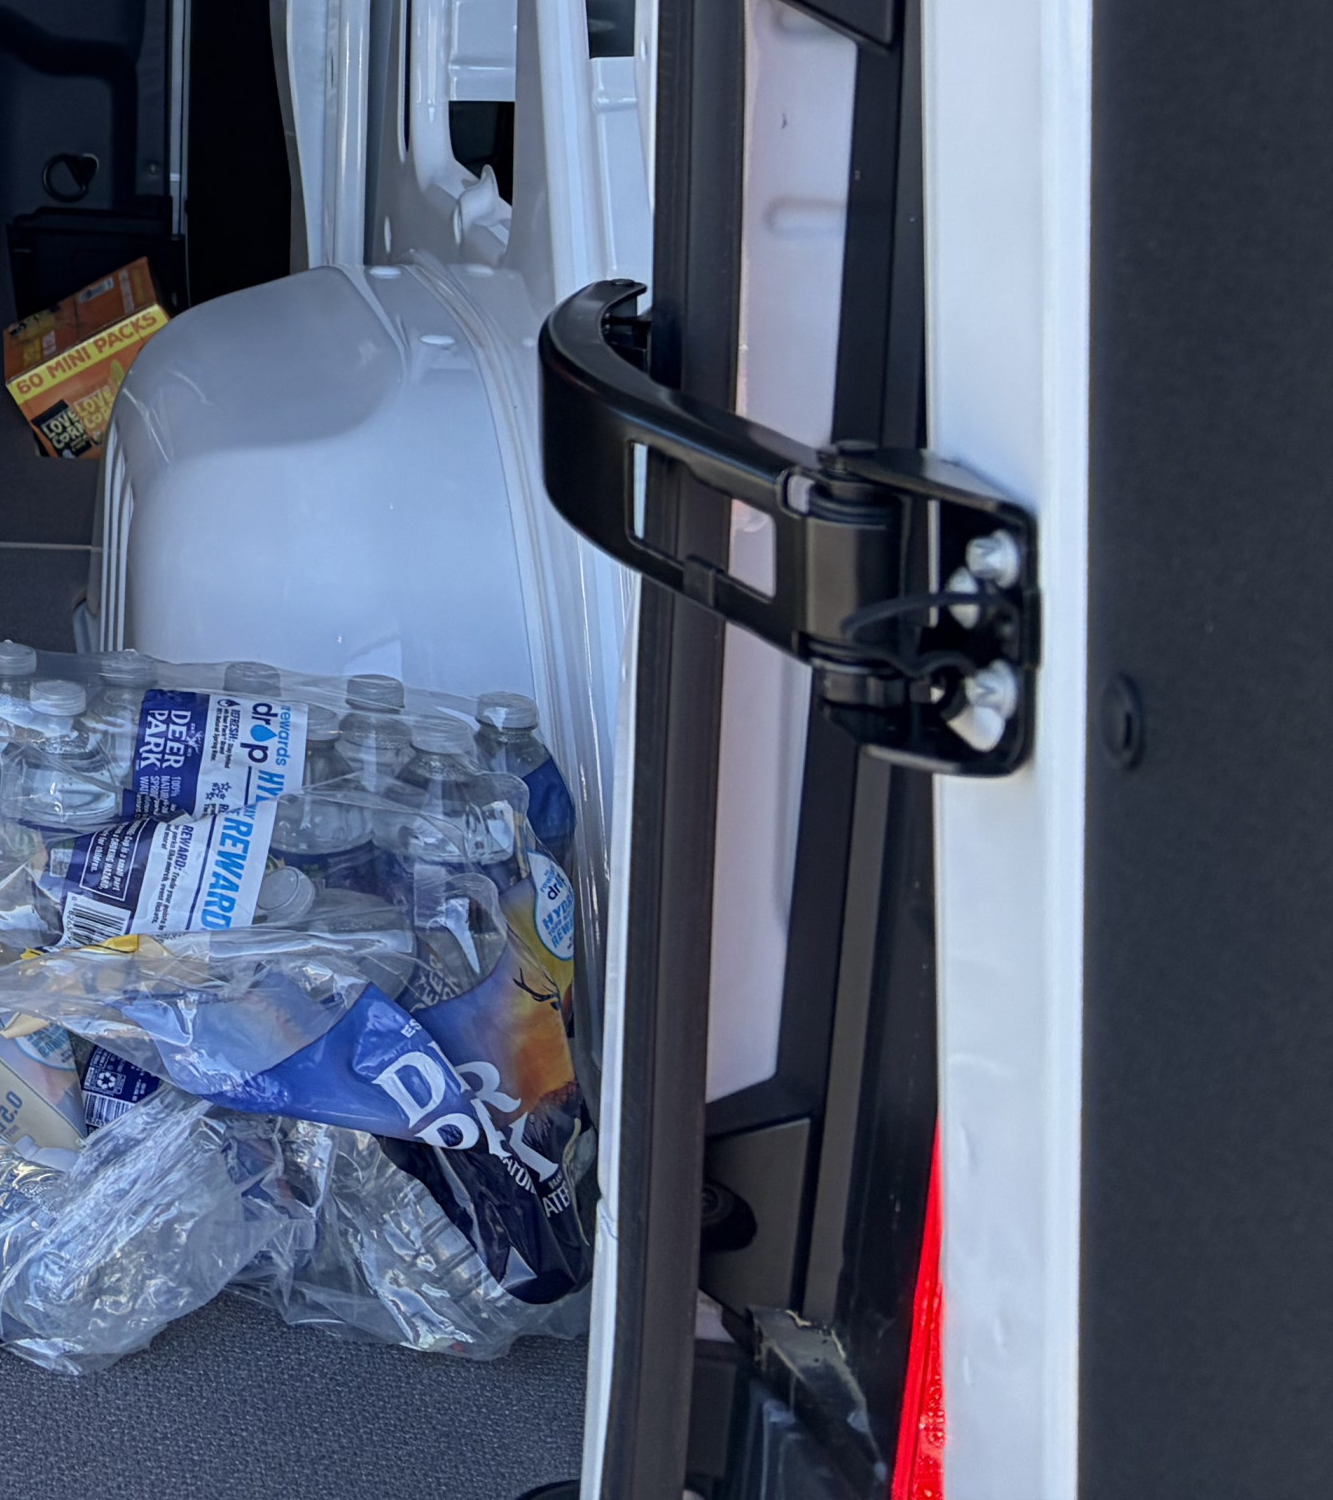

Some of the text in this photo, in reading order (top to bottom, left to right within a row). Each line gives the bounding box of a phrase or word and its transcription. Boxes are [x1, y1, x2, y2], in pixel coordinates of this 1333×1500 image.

[16, 312, 158, 395] 60 MINI PACKS
[41, 408, 80, 438] LOVE
[138, 708, 169, 771] PARK
[160, 709, 192, 770] DEER
[172, 824, 194, 871] REWARD:
[200, 815, 255, 931] REWARD
